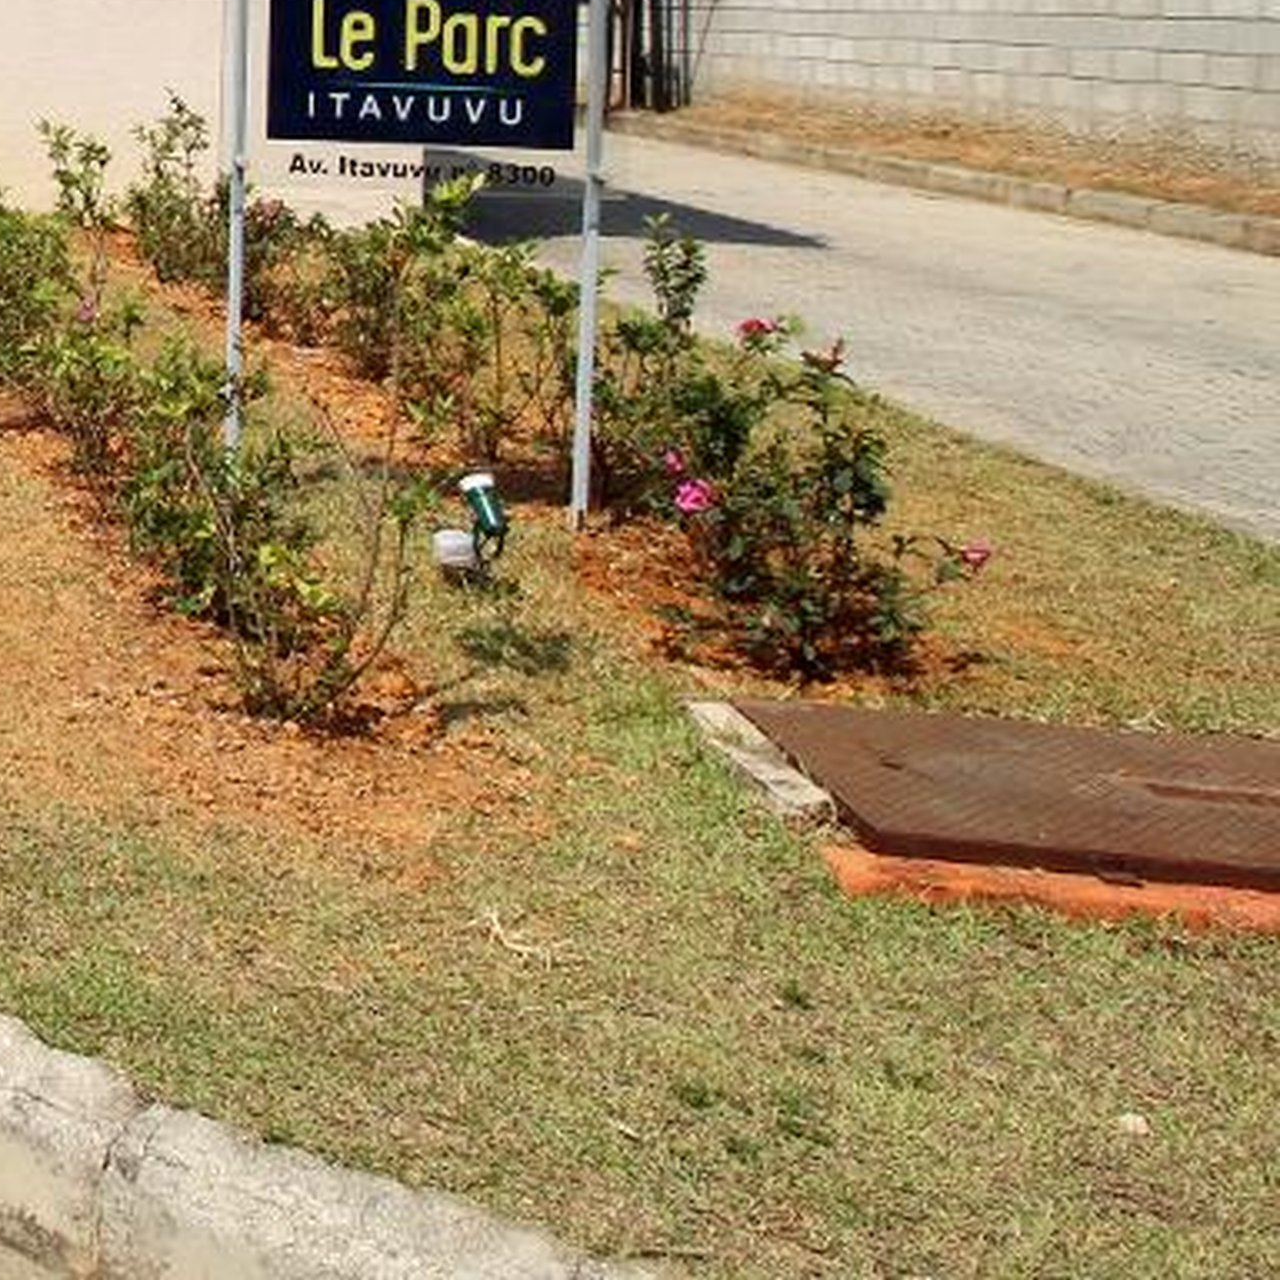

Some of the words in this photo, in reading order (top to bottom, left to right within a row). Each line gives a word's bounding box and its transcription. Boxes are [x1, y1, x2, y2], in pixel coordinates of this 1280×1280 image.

[308, 92, 523, 125] ITAVUVU
[289, 153, 328, 175] Av.
[485, 162, 556, 188] 8300
